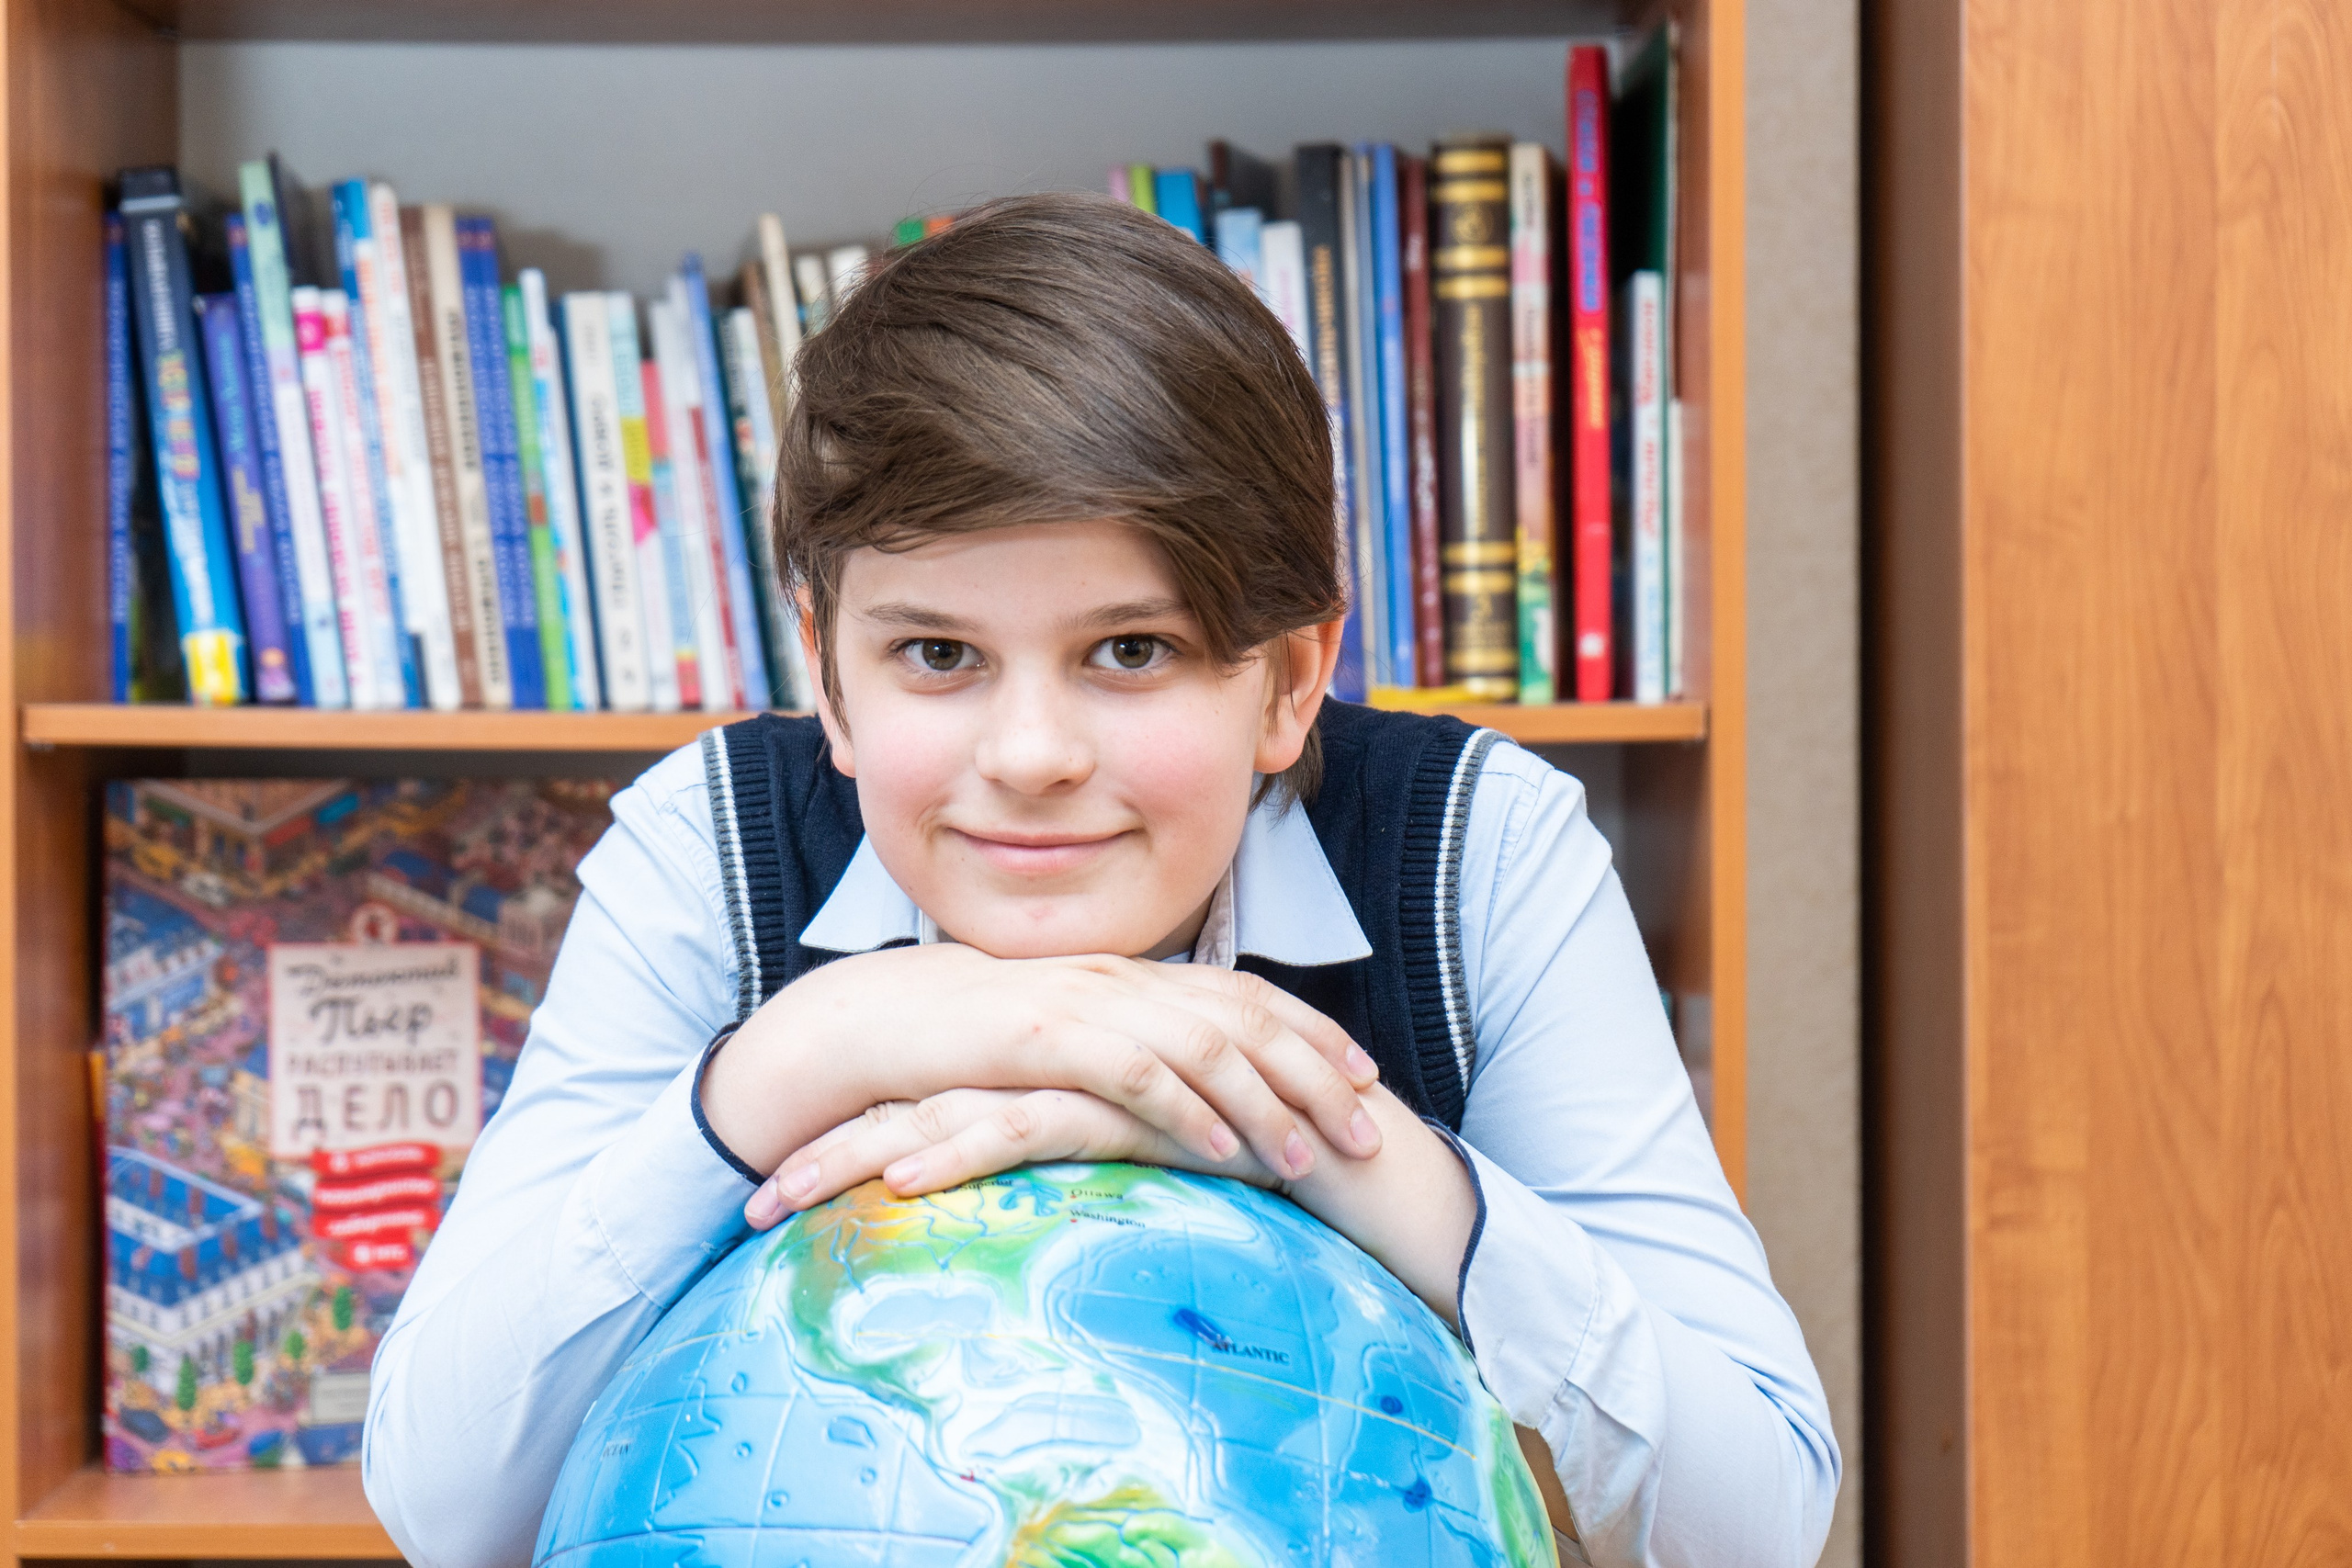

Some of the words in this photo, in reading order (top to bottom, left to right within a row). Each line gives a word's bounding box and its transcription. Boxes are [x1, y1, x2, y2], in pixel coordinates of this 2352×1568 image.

[294, 1081, 458, 1140] ДЕЛО
[1071, 1189, 1124, 1200] Ottawa
[1070, 1209, 1146, 1228] Washington
[1213, 1341, 1290, 1364] ATLANTIC
